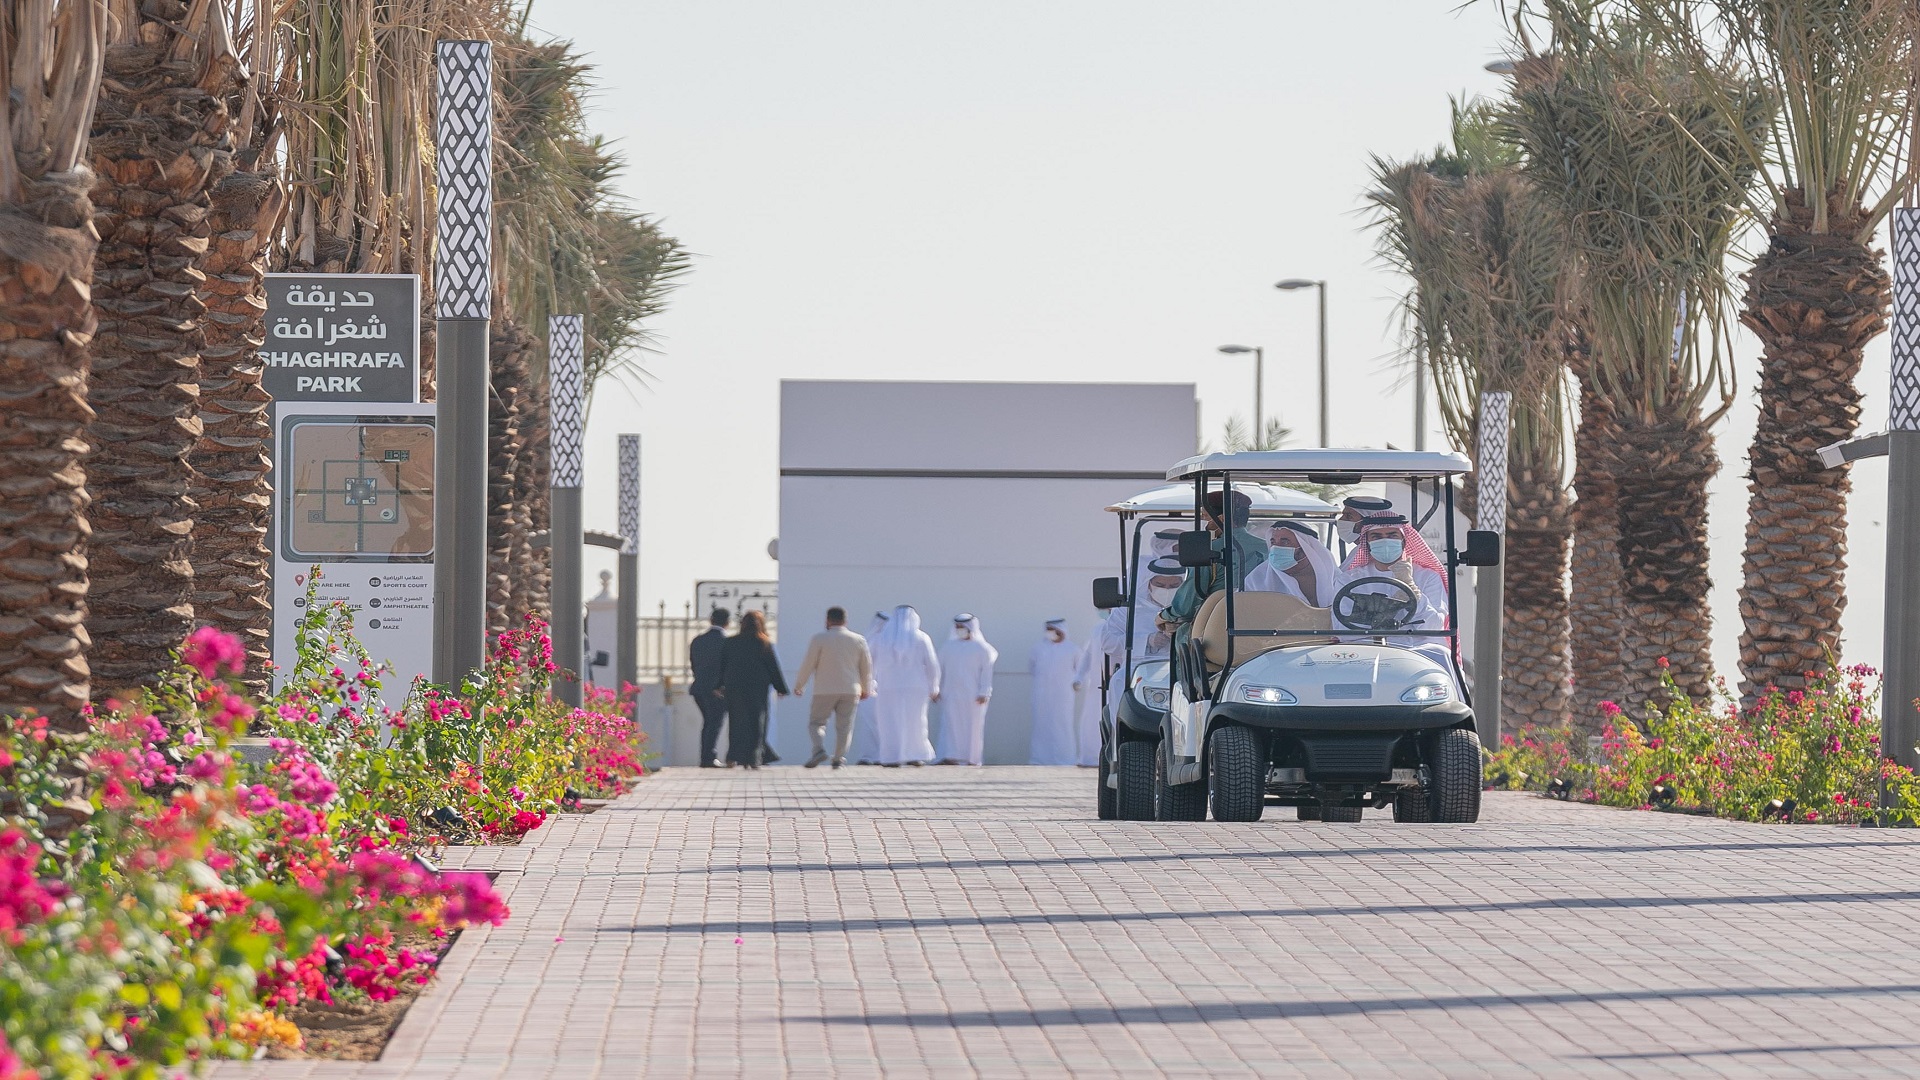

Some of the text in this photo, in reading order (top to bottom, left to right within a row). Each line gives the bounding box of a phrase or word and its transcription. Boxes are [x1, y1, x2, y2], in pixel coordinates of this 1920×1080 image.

[286, 284, 375, 312] حديقة
[273, 314, 387, 346] شغرافة
[258, 351, 405, 368] SHAGHRAFA
[296, 376, 363, 393] PARK
